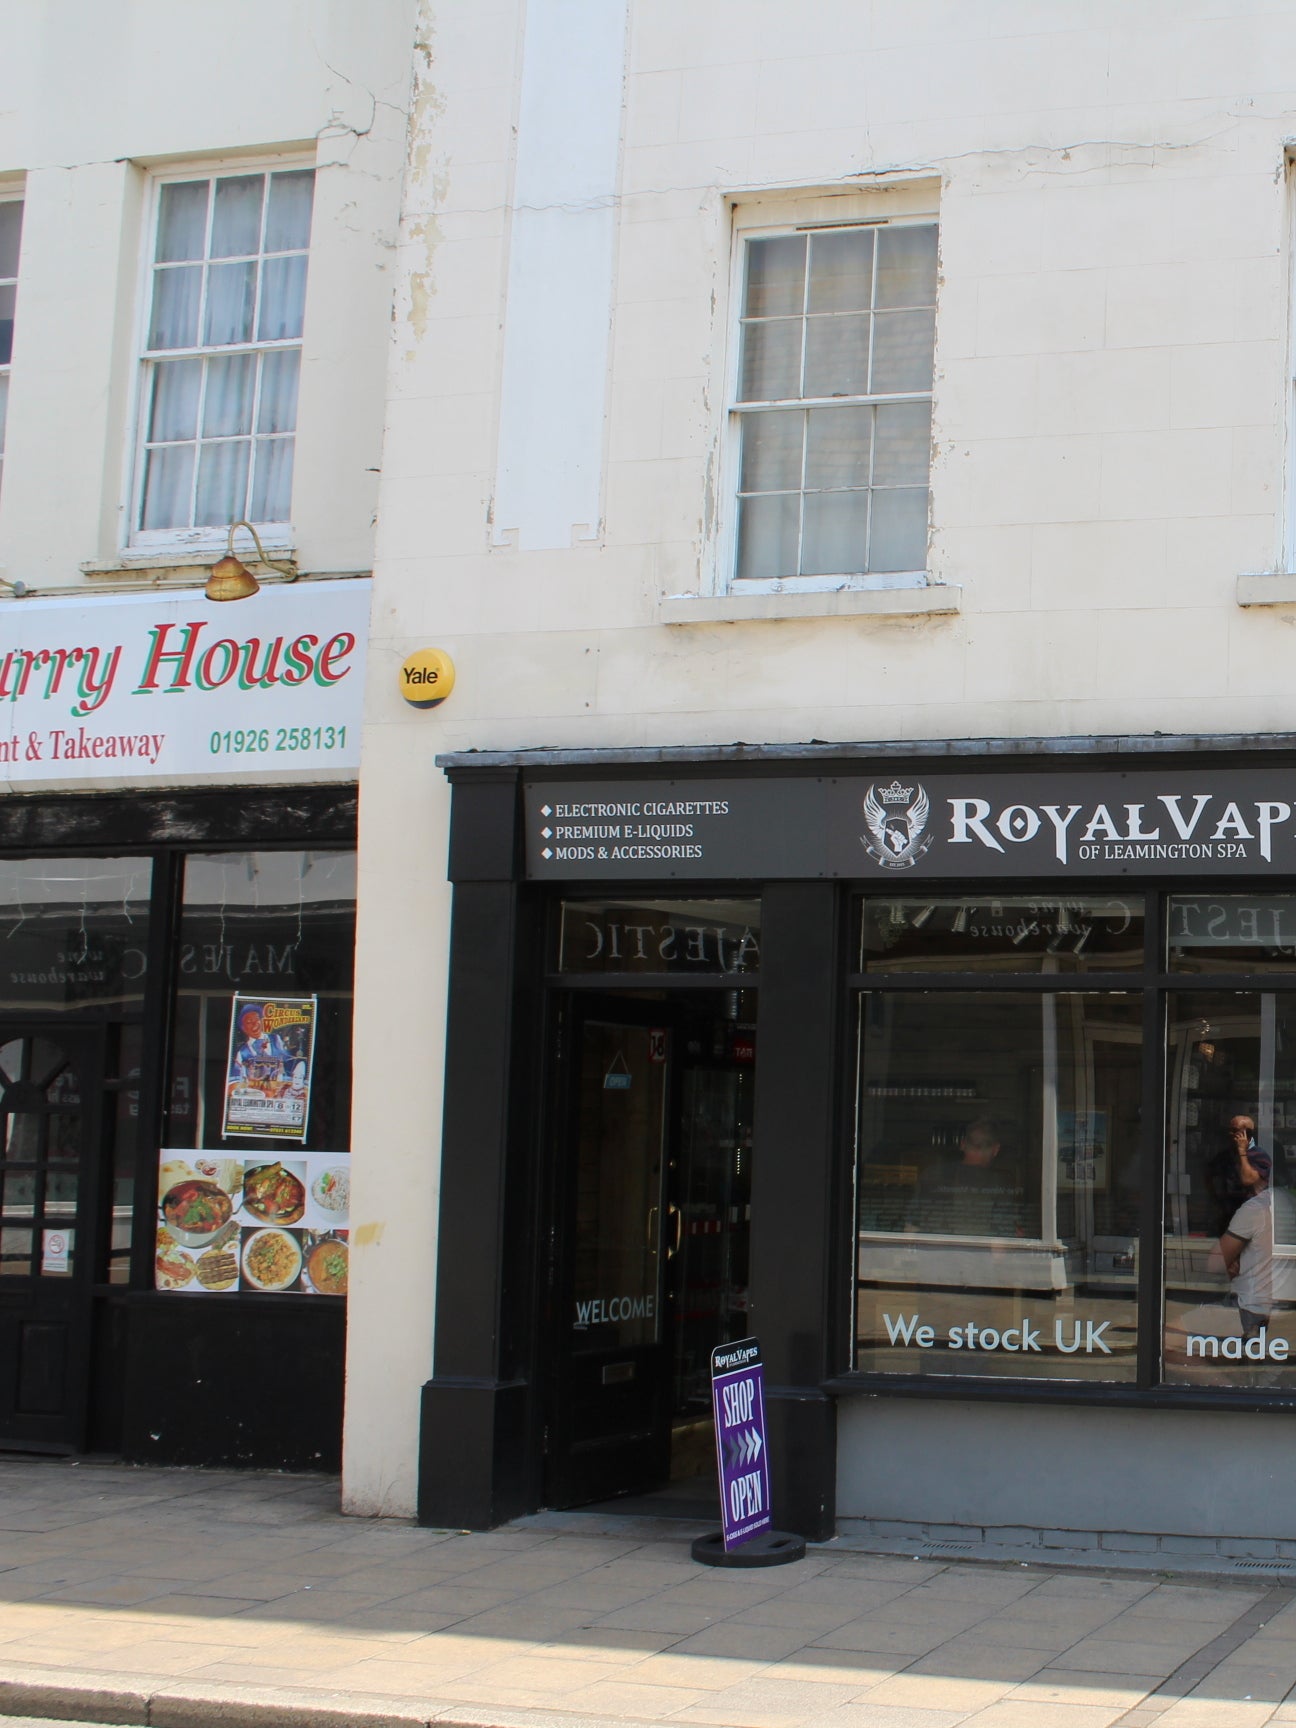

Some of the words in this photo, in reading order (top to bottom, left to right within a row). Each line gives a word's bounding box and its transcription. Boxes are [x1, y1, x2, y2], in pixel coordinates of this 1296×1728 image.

[132, 621, 355, 695] House
[403, 668, 438, 685] Yale
[25, 731, 43, 761] &
[50, 727, 165, 764] Takeaway
[210, 730, 269, 754] 01926
[276, 726, 347, 751] 258131
[555, 803, 641, 817] ELECTRONIC
[643, 801, 729, 816] CIGARETTES
[555, 825, 620, 839] PREMIUM
[624, 824, 694, 840] E-LIQUIDS
[555, 847, 595, 859] MODS
[597, 847, 608, 859] &
[611, 845, 702, 859] ACCESSORIES
[1079, 845, 1100, 860] OF
[1105, 844, 1213, 860] LEAMINGTON
[1218, 843, 1247, 858] SPA
[576, 1295, 655, 1324] WELCOME
[883, 1313, 935, 1348] We
[948, 1318, 1041, 1353] stock
[1055, 1320, 1112, 1355] UK
[1186, 1327, 1288, 1362] made
[722, 1378, 755, 1428] SHOP
[730, 1470, 762, 1523] OPEN
